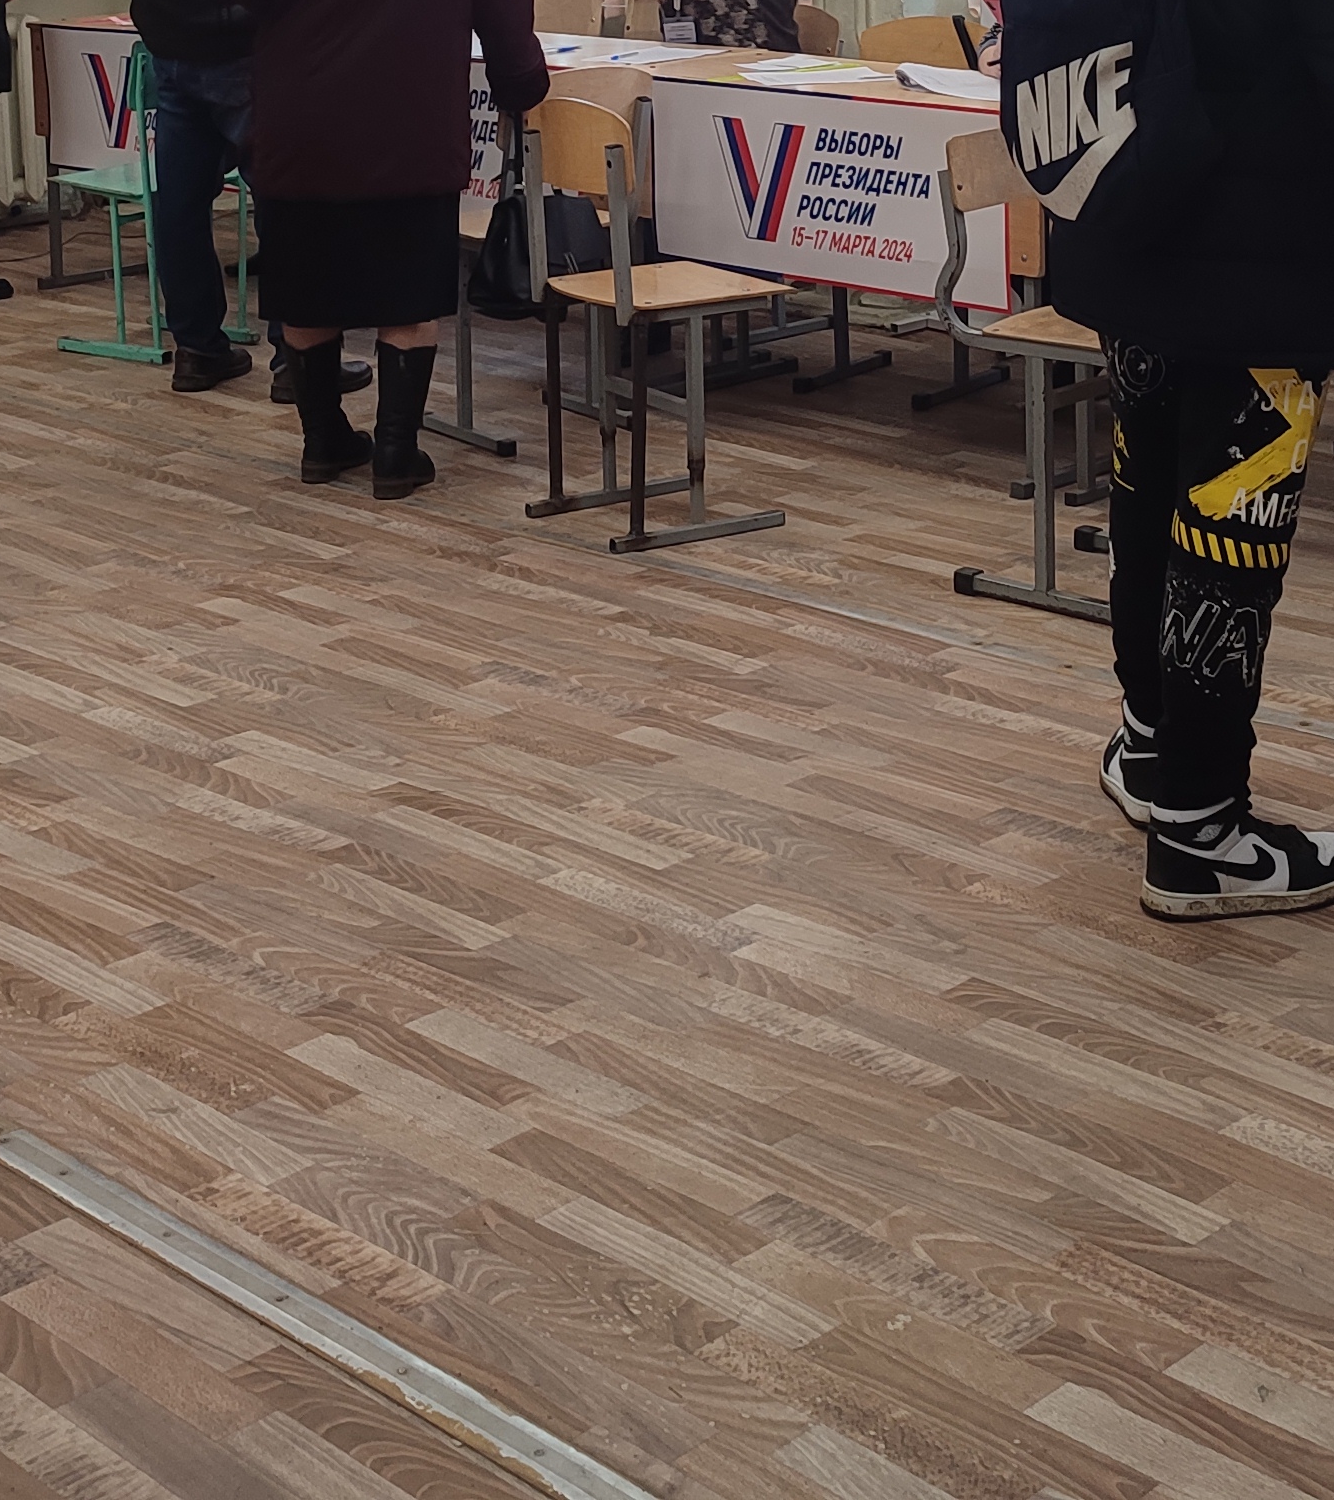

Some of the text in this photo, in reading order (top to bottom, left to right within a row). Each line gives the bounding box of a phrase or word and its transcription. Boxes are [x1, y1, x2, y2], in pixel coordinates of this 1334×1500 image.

[1015, 41, 1134, 173] NIKE
[814, 127, 903, 160] ВЫБОРЫ
[805, 161, 931, 199] ПРЕЗИДЕНТА
[797, 194, 877, 227] РОССИИ
[829, 231, 877, 258] МАРТА
[878, 238, 913, 263] 2024
